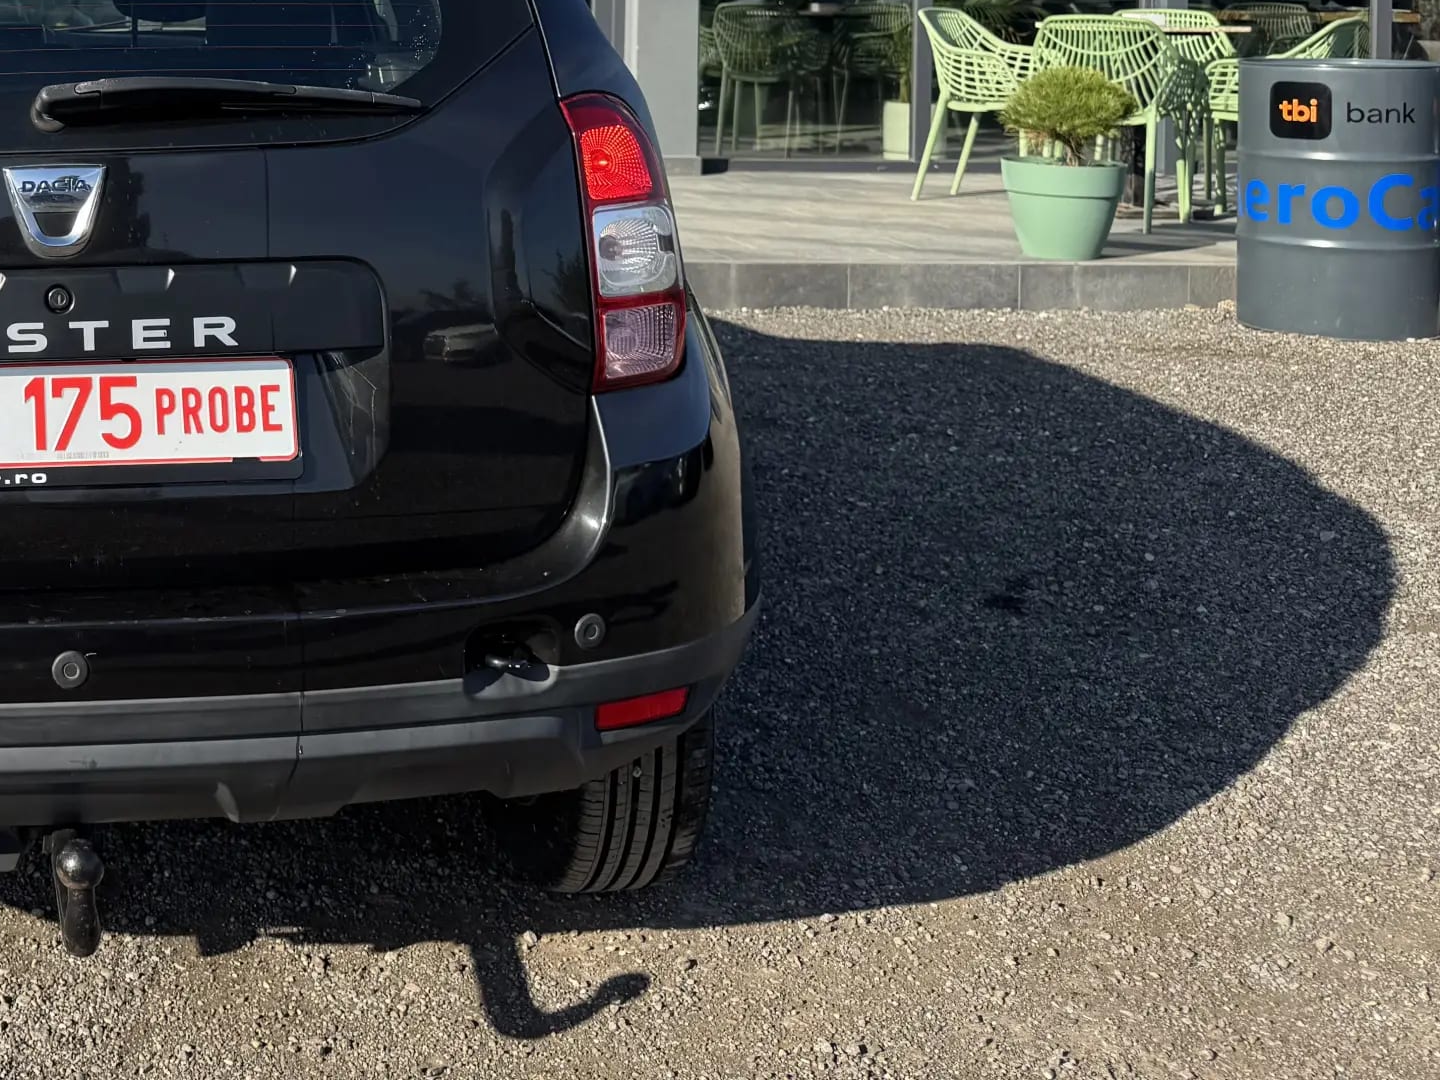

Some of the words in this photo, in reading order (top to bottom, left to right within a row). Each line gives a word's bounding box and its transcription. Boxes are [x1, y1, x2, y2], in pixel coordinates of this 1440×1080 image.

[1279, 99, 1318, 123] tbi
[1346, 101, 1415, 124] bank
[20, 179, 92, 193] DACIA
[1238, 172, 1440, 232] eroCa
[24, 375, 143, 452] 175
[155, 384, 283, 436] PROBE
